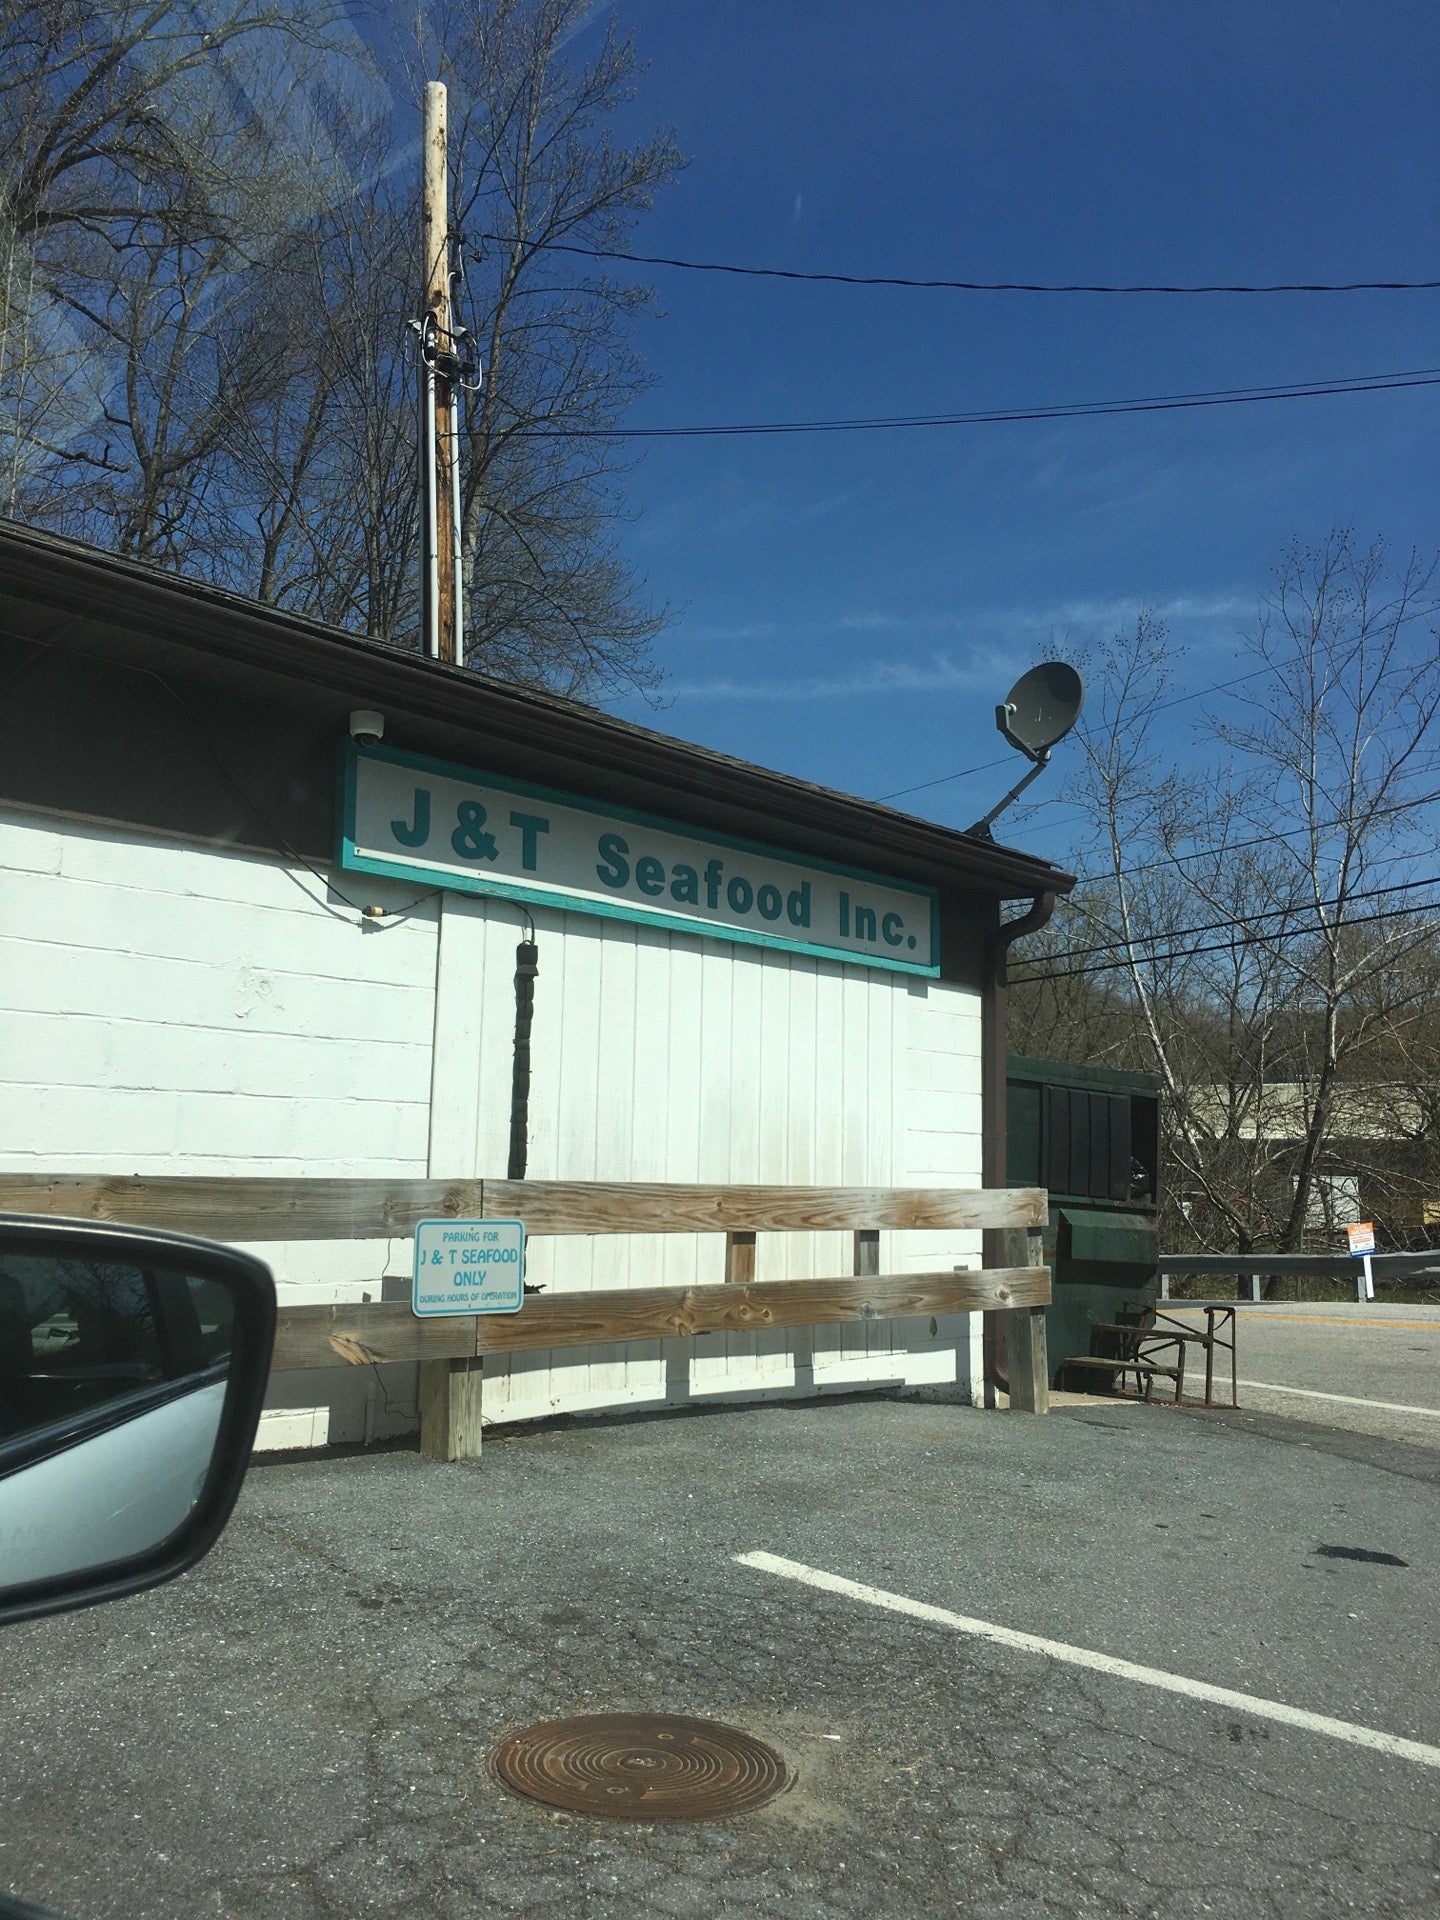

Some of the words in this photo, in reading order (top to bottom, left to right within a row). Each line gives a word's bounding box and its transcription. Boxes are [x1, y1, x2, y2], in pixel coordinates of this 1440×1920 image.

[596, 833, 811, 927] Seafood
[839, 892, 917, 950] Inc.
[443, 1232, 480, 1242] PARKING
[483, 1232, 499, 1241] FOR
[462, 1248, 518, 1264] SEAFOOD
[453, 1270, 487, 1286] ONLY
[420, 1294, 445, 1303] DURING
[447, 1293, 468, 1302] HOURS
[470, 1292, 479, 1301] OF
[481, 1291, 517, 1300] OPERATION
